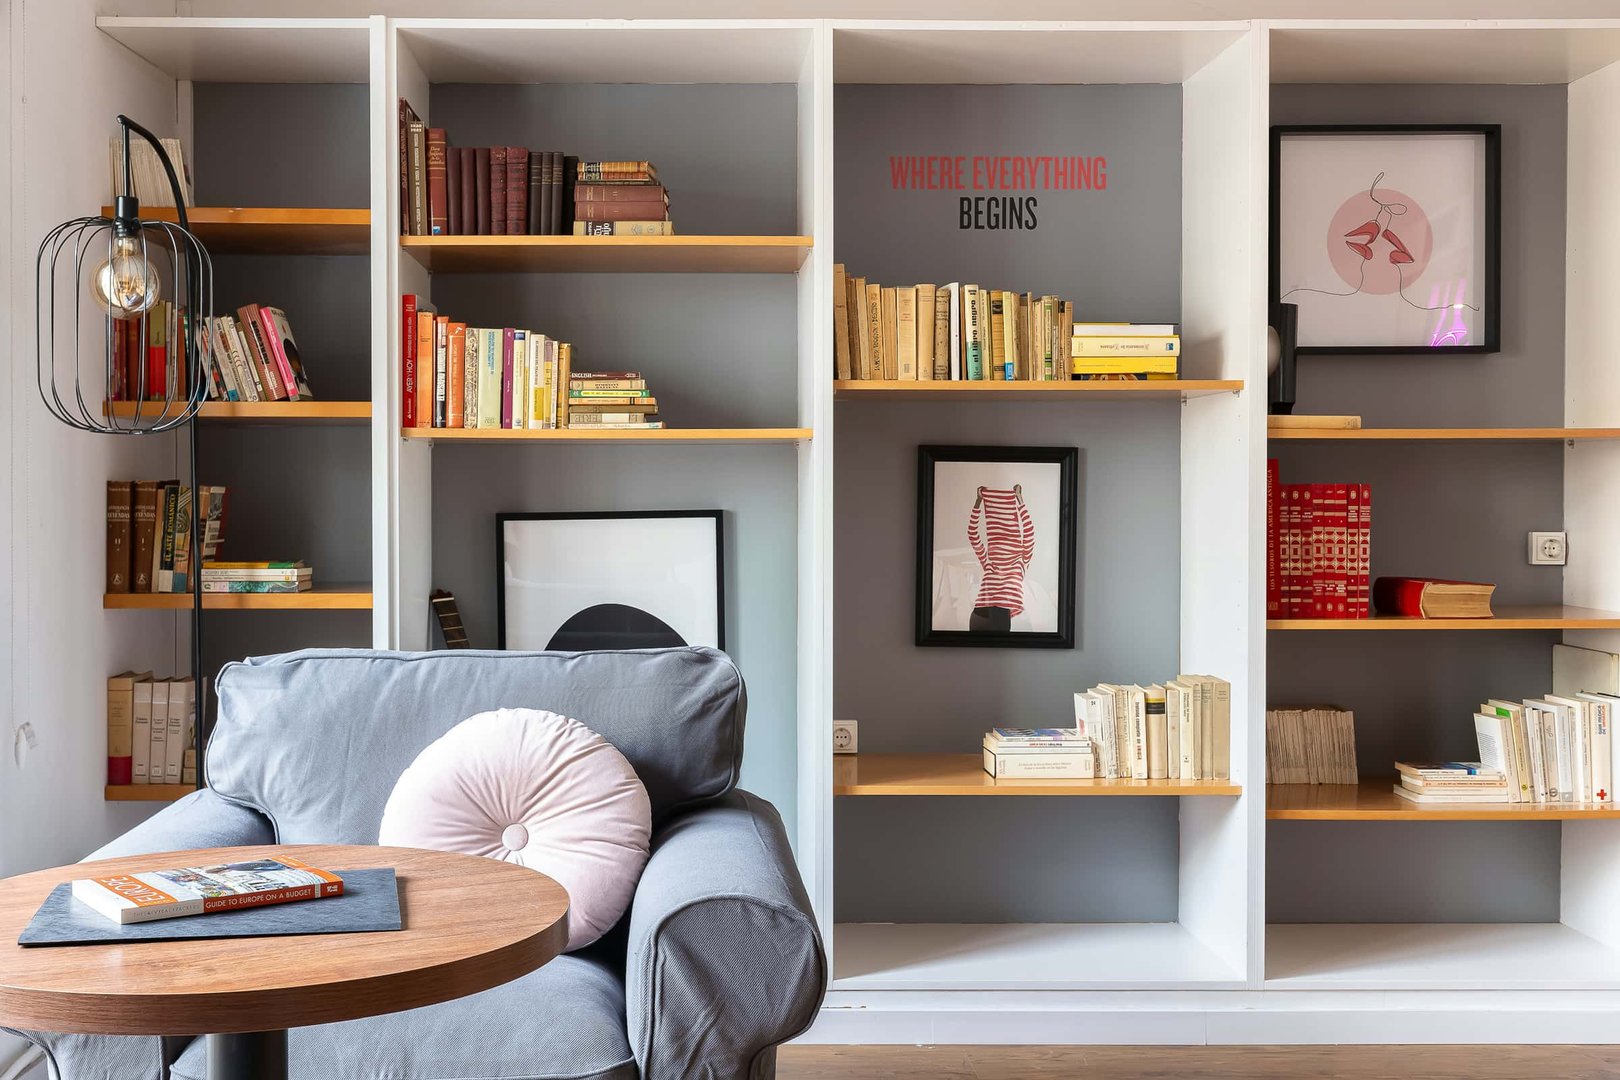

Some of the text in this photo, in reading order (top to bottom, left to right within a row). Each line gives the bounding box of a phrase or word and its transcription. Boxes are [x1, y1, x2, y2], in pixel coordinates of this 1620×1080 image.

[889, 156, 1108, 190] WHERE EVERYTHING
[960, 196, 1038, 230] BEGINS
[972, 354, 979, 363] el
[165, 554, 171, 562] EL
[101, 876, 166, 902] EUROPE
[206, 900, 227, 909] GUIDE
[240, 895, 264, 904] EUROPE
[266, 893, 278, 901] ON
[286, 888, 311, 898] BUDGET
